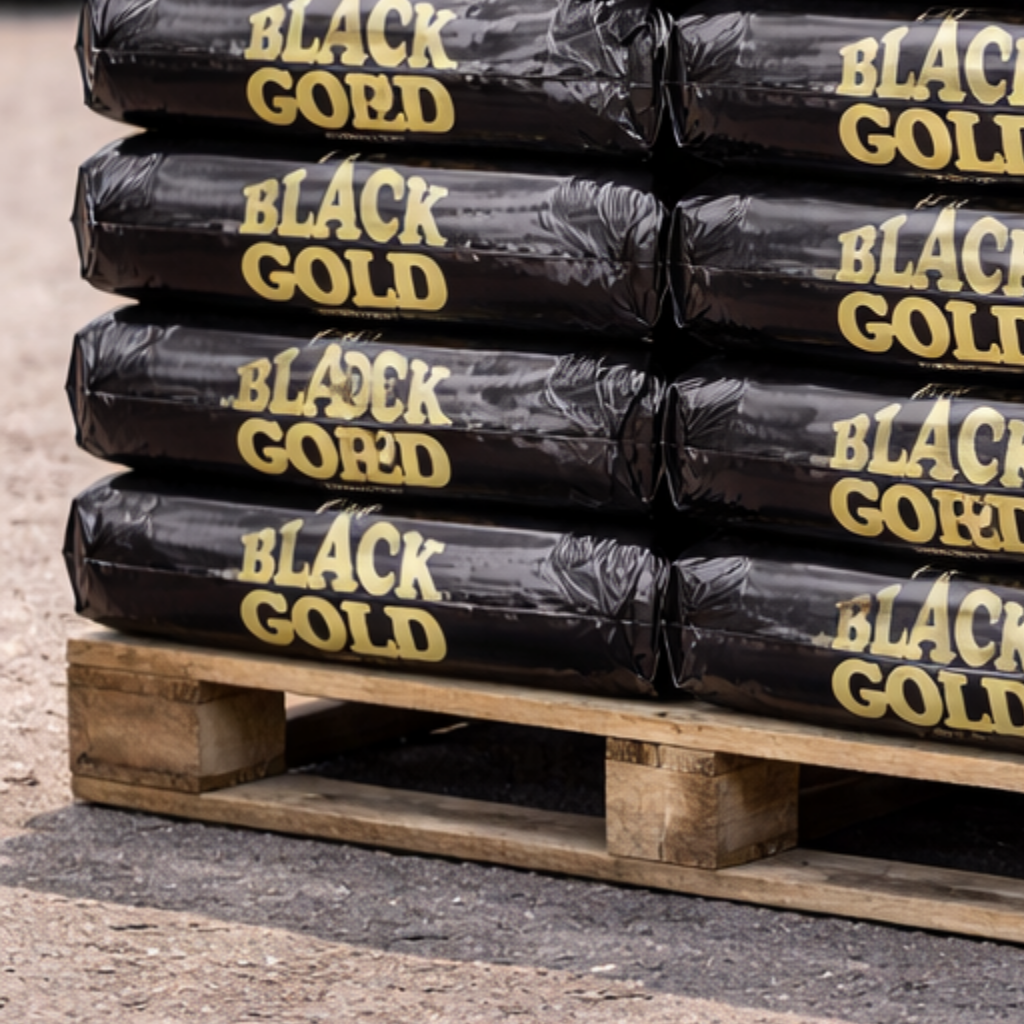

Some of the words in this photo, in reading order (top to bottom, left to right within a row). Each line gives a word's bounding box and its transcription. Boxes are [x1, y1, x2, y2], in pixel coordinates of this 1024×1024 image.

[238, 158, 447, 247] BLACK
[241, 241, 448, 311] GOLD
[236, 514, 446, 602] BLACK
[240, 589, 447, 662] GOLD
